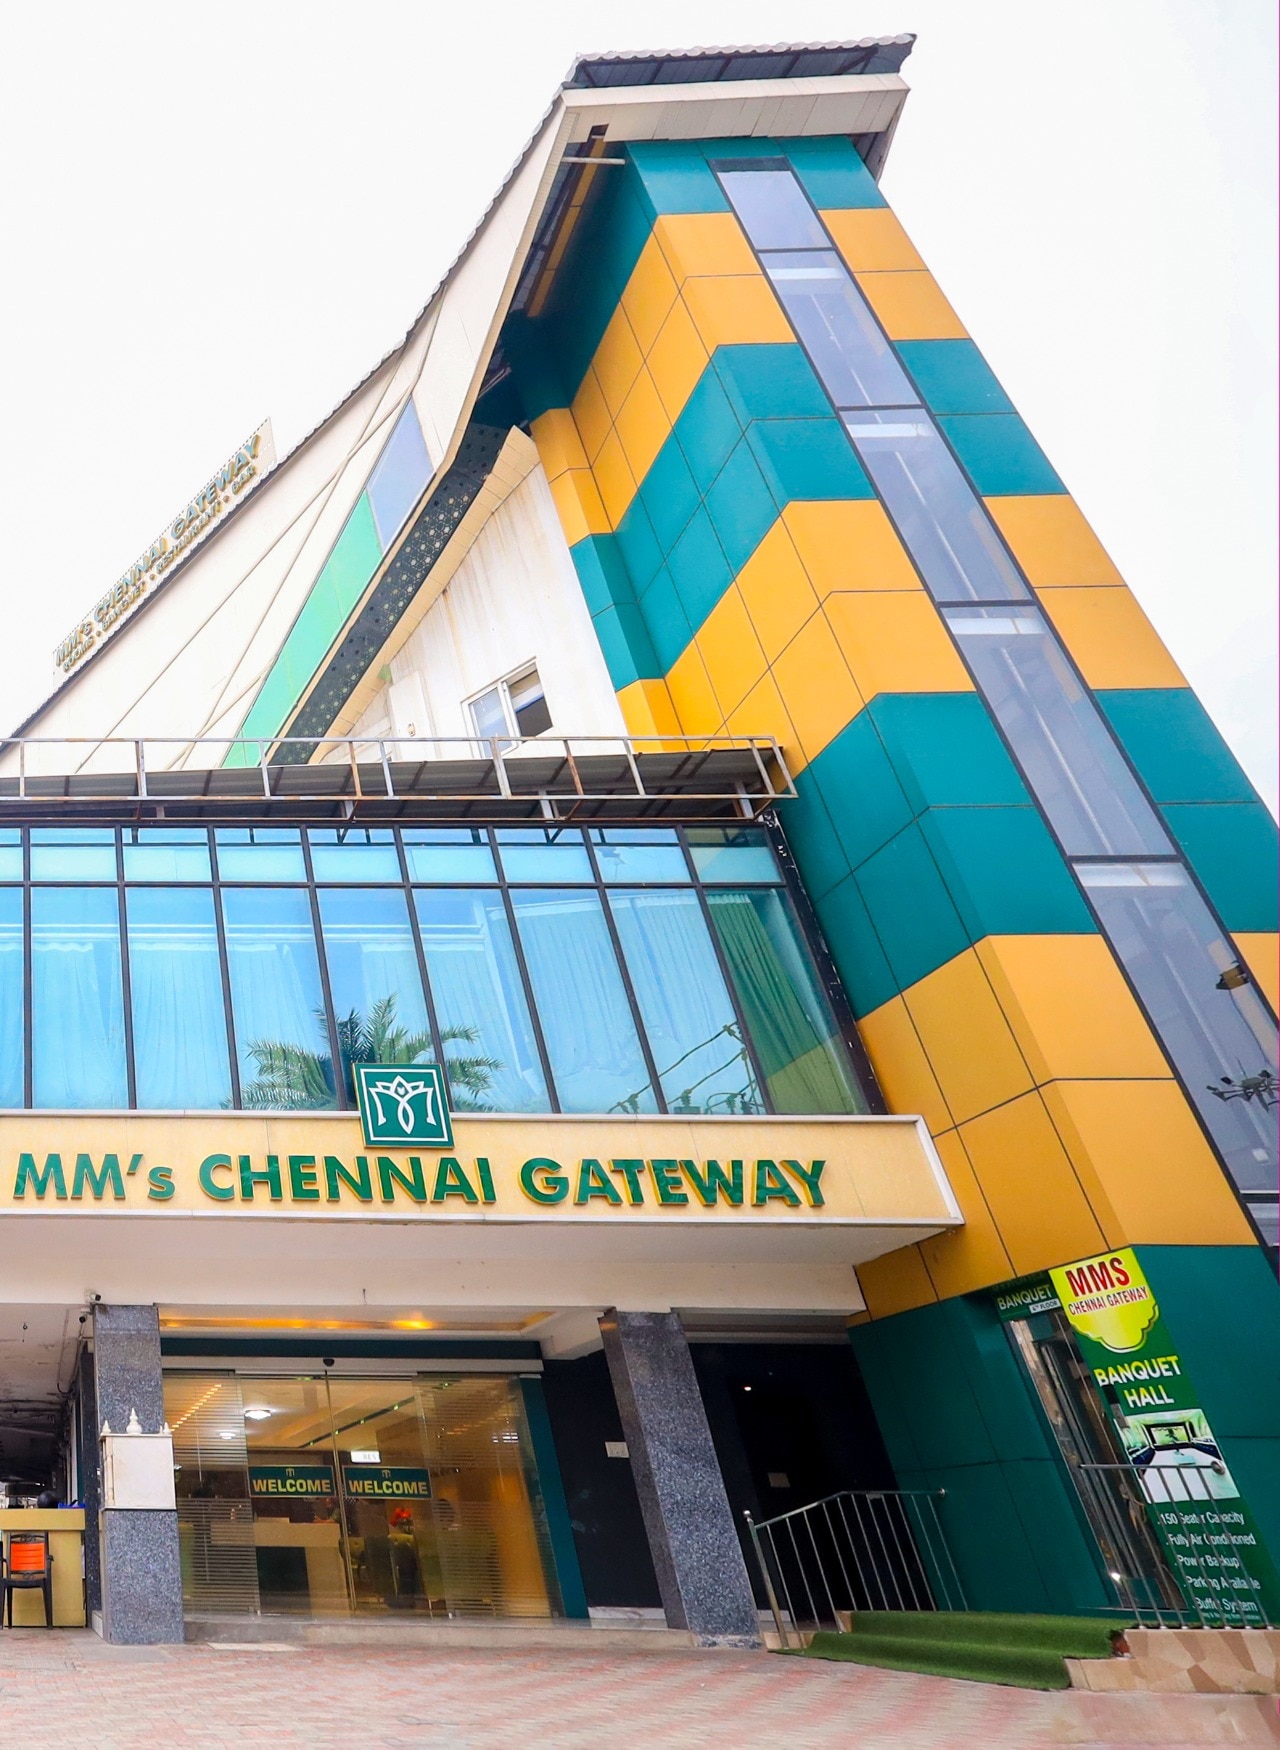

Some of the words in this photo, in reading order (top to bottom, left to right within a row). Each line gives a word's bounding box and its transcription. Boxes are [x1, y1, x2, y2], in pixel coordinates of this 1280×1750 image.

[93, 537, 168, 624] CHENNAI
[171, 434, 261, 540] GATEWAY
[198, 1153, 497, 1204] CHENNAI
[518, 1157, 827, 1207] GATEWAY
[1065, 1257, 1131, 1298] MMS
[997, 1284, 1054, 1311] BANQUET
[1067, 1295, 1108, 1316] CHENNAI
[1107, 1285, 1150, 1308] GATEWAY
[1093, 1355, 1182, 1387] BANQUET
[1123, 1384, 1175, 1409] HALL
[252, 1478, 332, 1494] WELCOME
[348, 1479, 429, 1495] WELCOME
